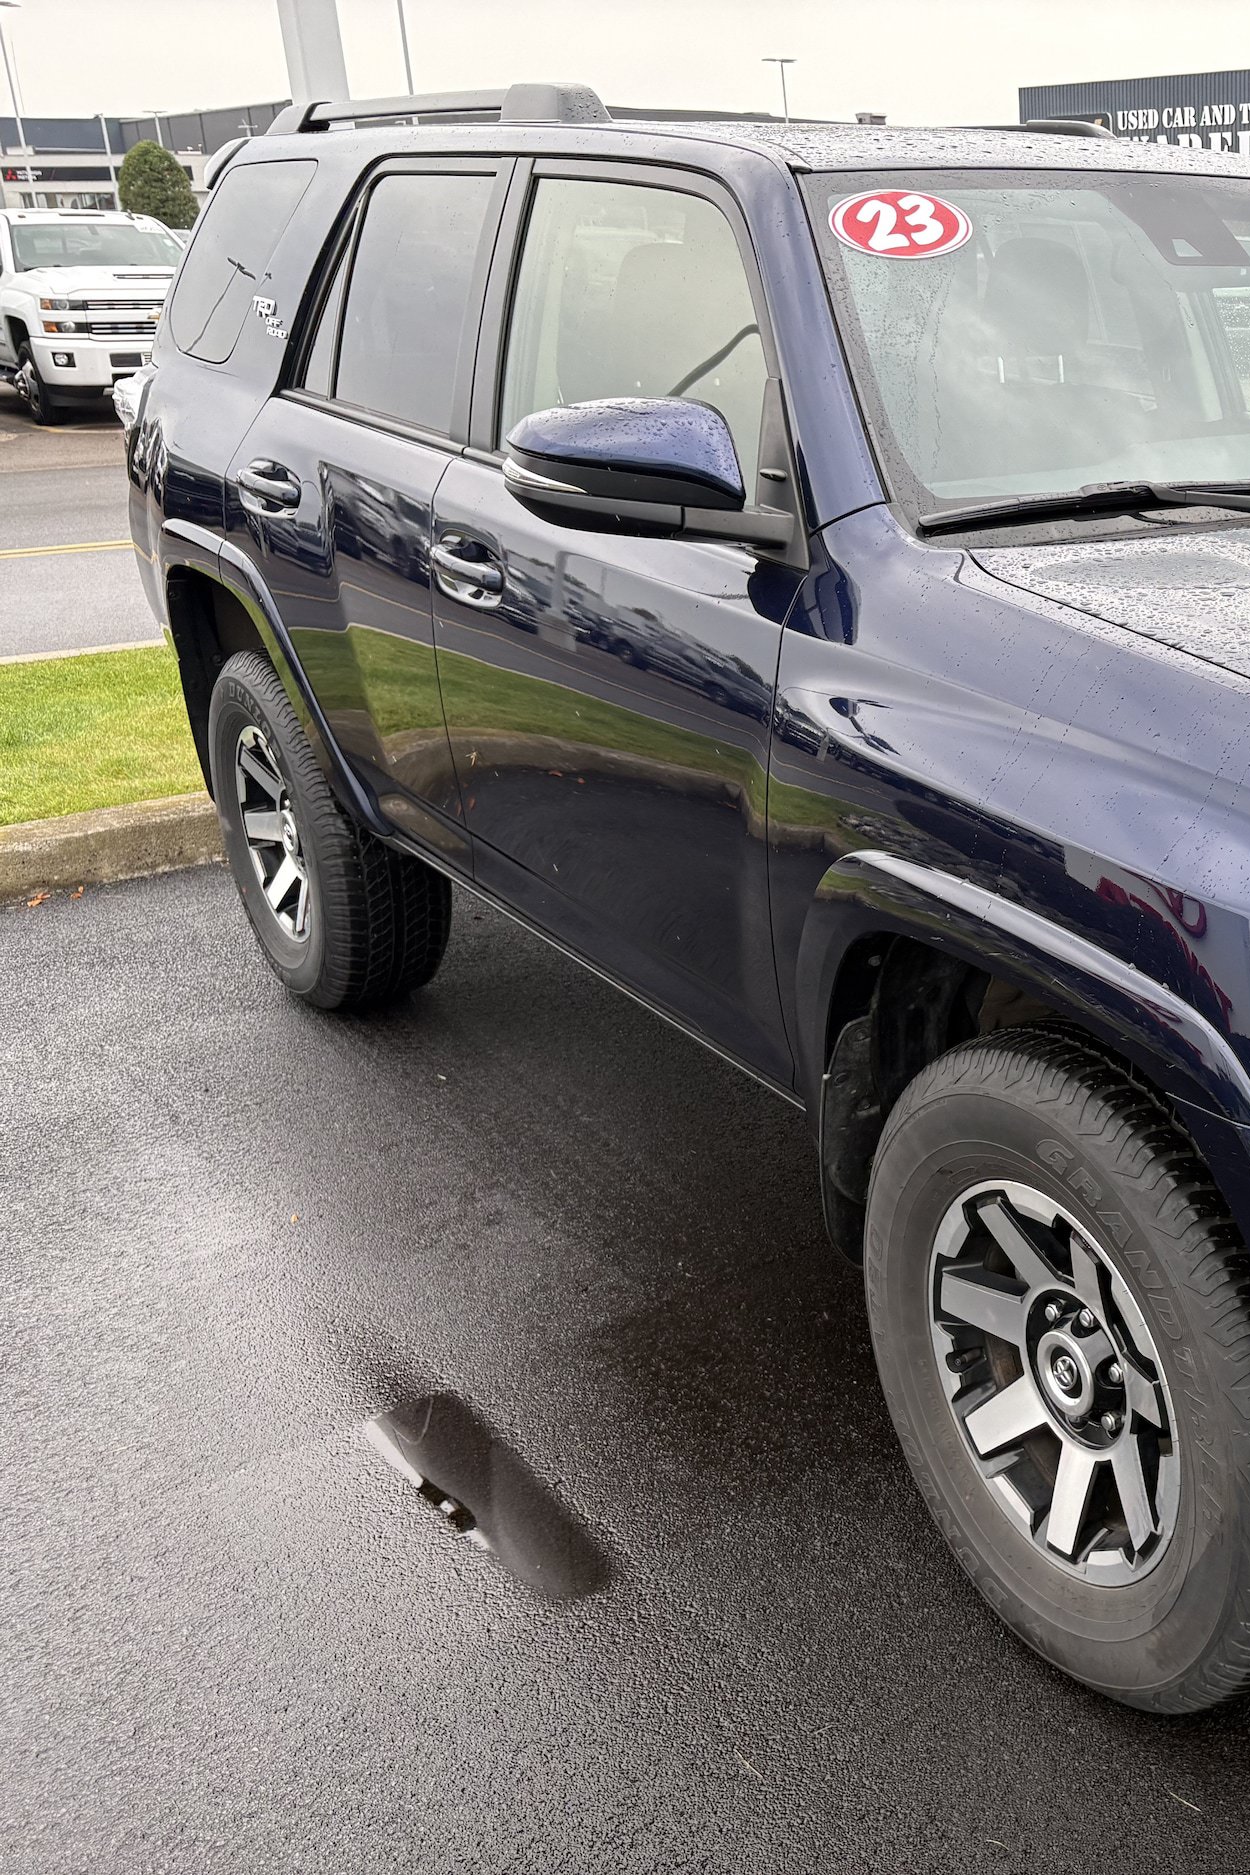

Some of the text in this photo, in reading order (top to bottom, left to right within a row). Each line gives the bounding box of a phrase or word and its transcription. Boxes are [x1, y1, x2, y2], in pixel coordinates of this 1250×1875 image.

[1117, 109, 1159, 130] USED
[1162, 106, 1196, 128] CAR
[1200, 103, 1236, 126] AND
[856, 194, 945, 251] 23
